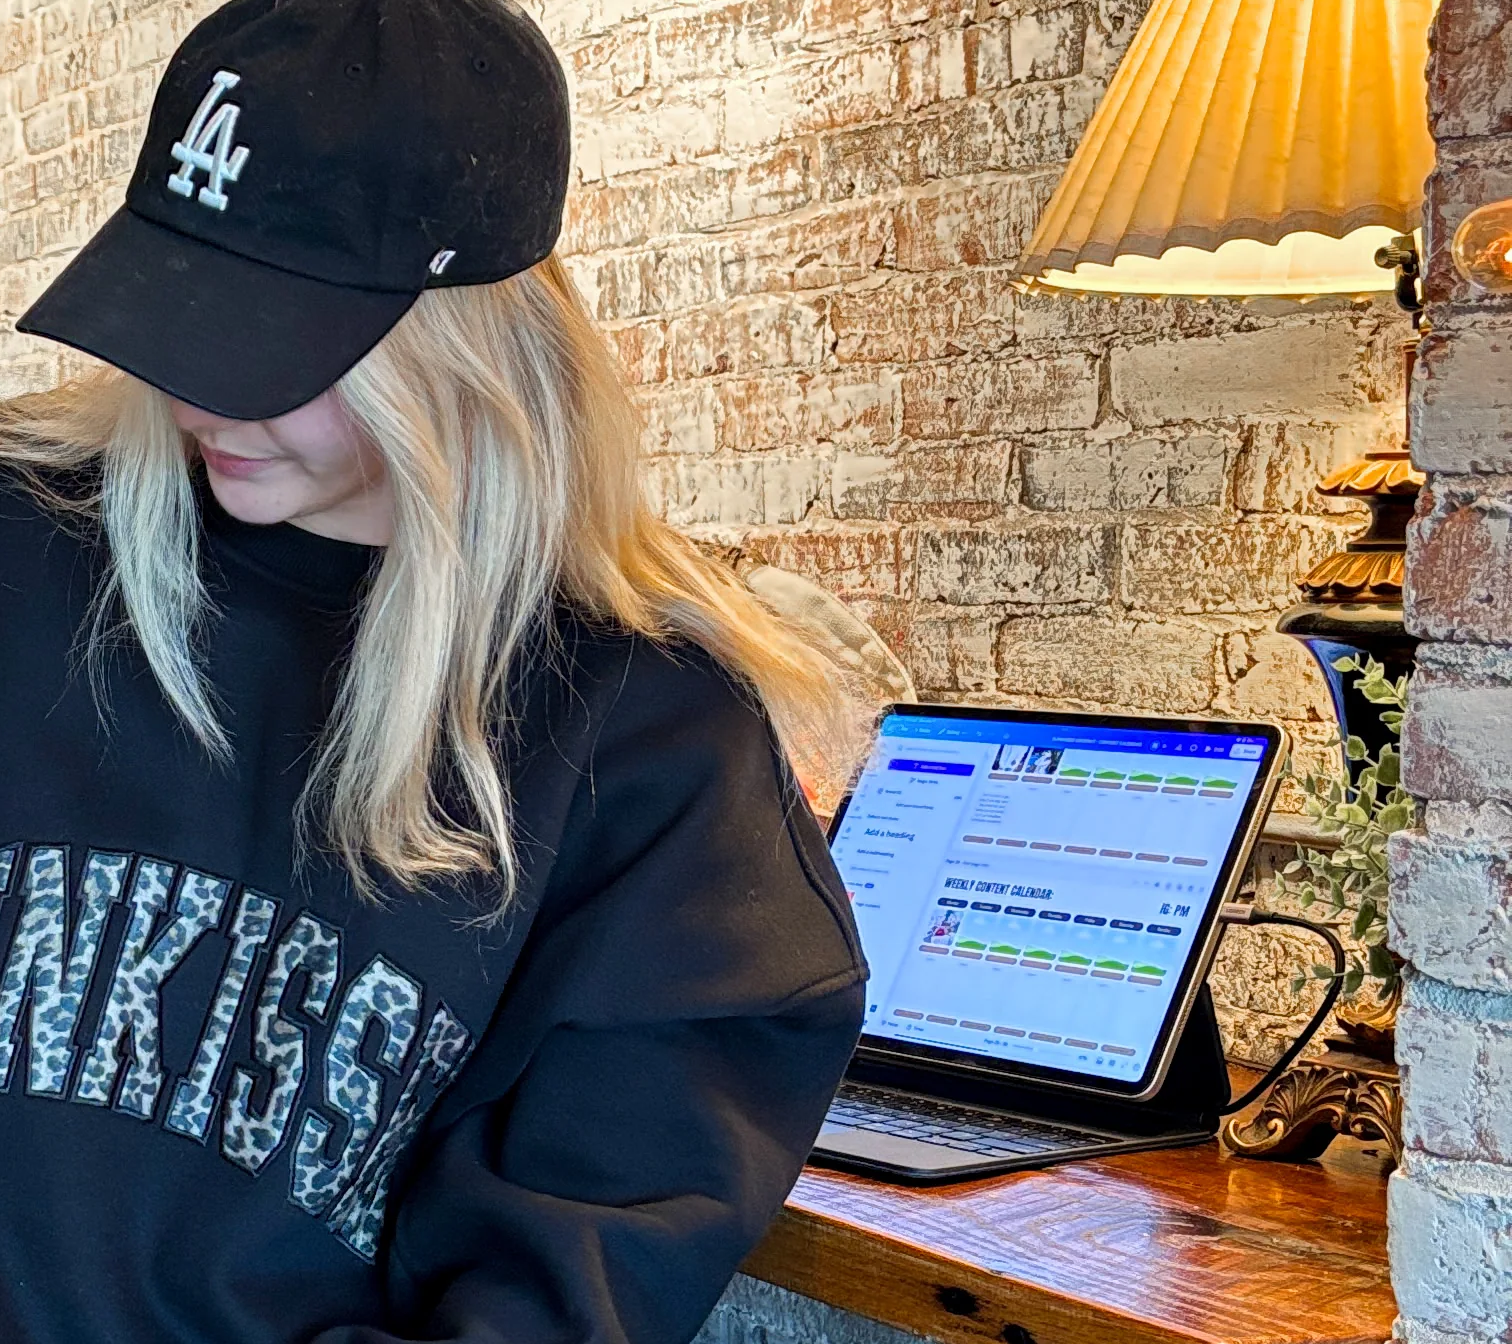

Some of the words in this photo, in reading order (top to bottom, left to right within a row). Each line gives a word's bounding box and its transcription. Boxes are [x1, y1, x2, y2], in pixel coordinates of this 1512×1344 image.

[168, 70, 250, 211] LA
[944, 877, 976, 892] WEEKLY
[975, 880, 1011, 896] CONTENT
[1173, 904, 1191, 917] PM
